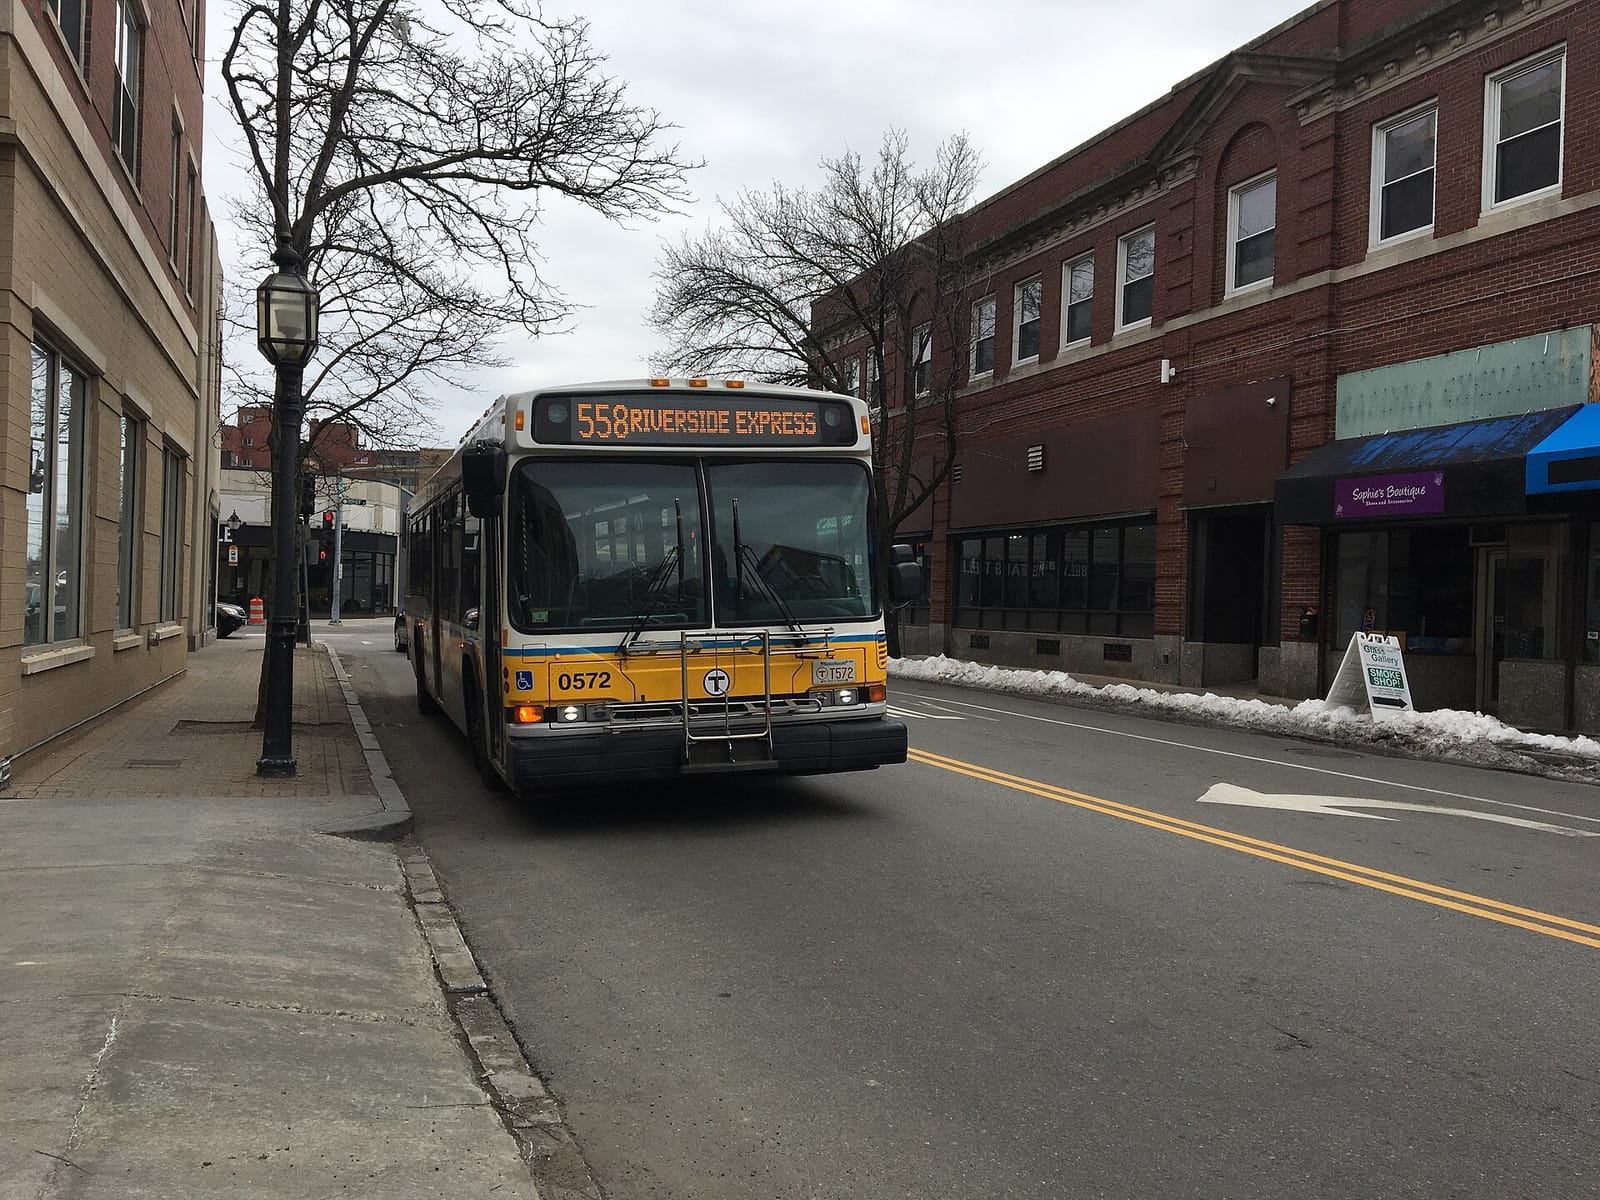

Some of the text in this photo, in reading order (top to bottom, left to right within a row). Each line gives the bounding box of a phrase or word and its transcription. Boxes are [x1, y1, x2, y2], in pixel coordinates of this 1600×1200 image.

[577, 403, 817, 438] 558 RIVERSIDE EXPRESS
[1352, 485, 1426, 504] Sophie's Boutique
[1364, 644, 1385, 655] Glass
[1371, 653, 1399, 666] Gallery
[830, 667, 854, 679] T572
[1369, 668, 1401, 680] SMOKE
[558, 671, 612, 691] 0572
[707, 675, 726, 692] T
[1373, 677, 1401, 688] SHOP!
